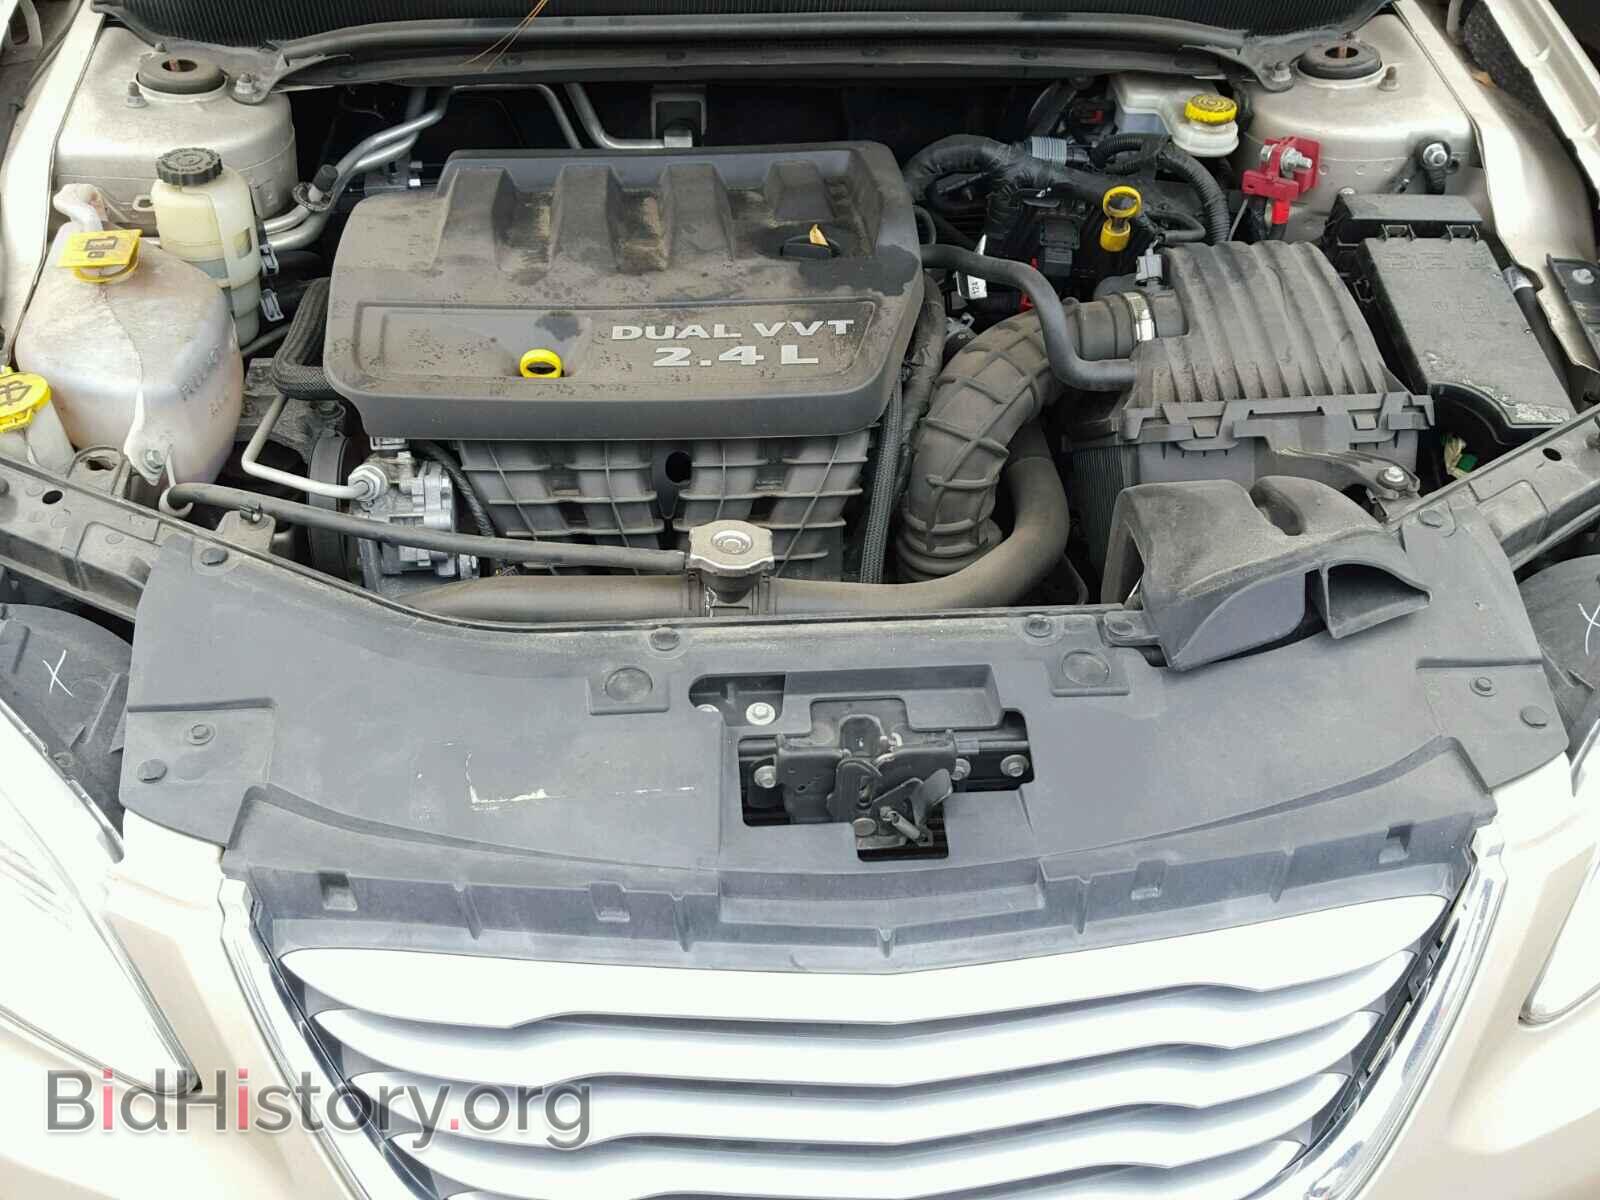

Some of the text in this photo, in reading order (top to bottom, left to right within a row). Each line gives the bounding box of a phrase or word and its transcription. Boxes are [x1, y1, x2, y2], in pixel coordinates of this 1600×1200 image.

[611, 319, 855, 340] DUAL VVT
[653, 344, 820, 367] 2.4 L
